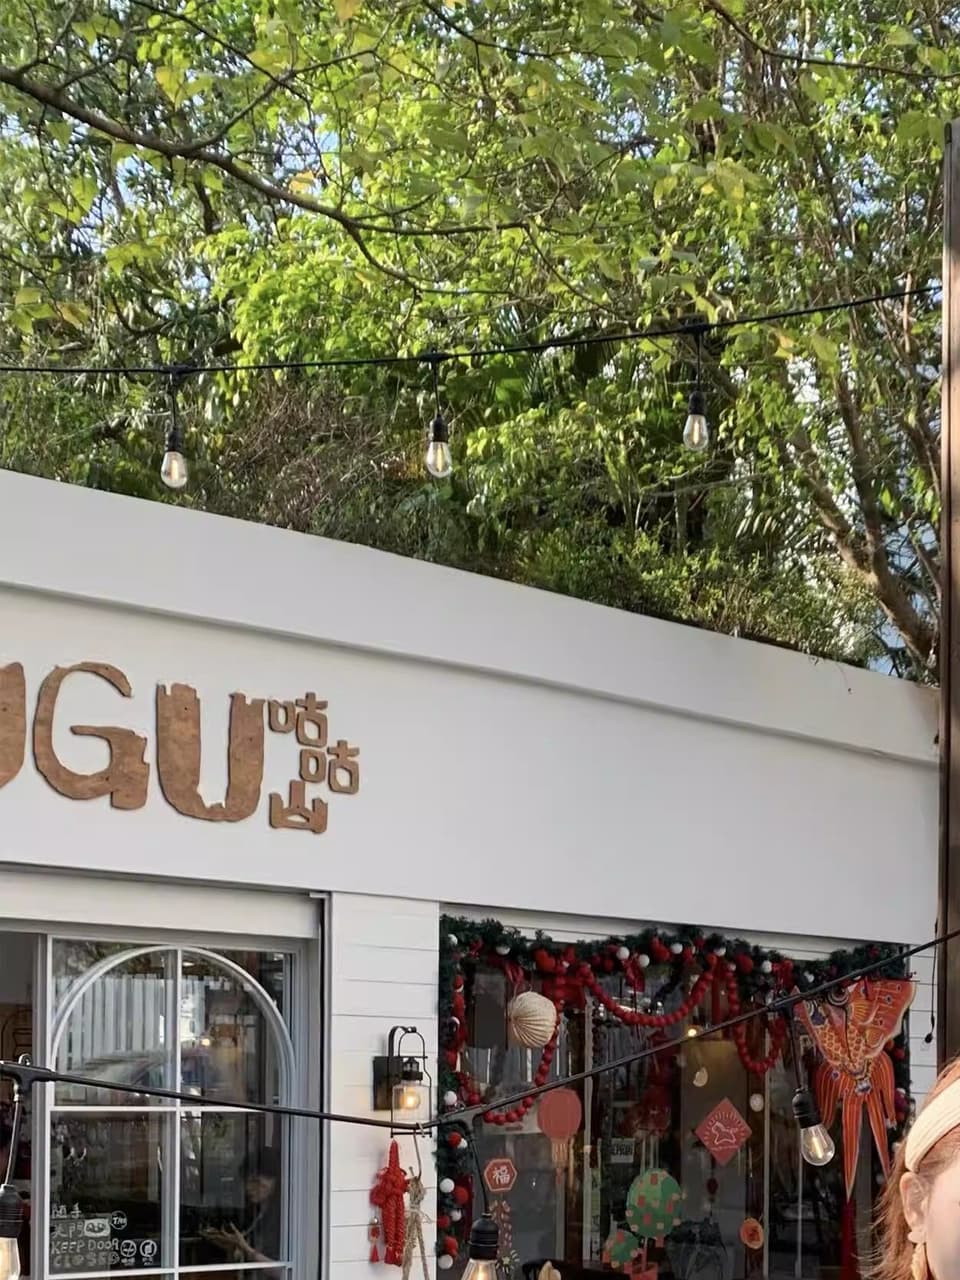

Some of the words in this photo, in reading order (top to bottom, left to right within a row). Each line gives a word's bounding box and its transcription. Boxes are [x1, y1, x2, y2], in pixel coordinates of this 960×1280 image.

[0, 661, 265, 823] GU
[492, 1165, 510, 1185] 福
[51, 1239, 85, 1254] KEEP
[88, 1238, 119, 1251] DOOR
